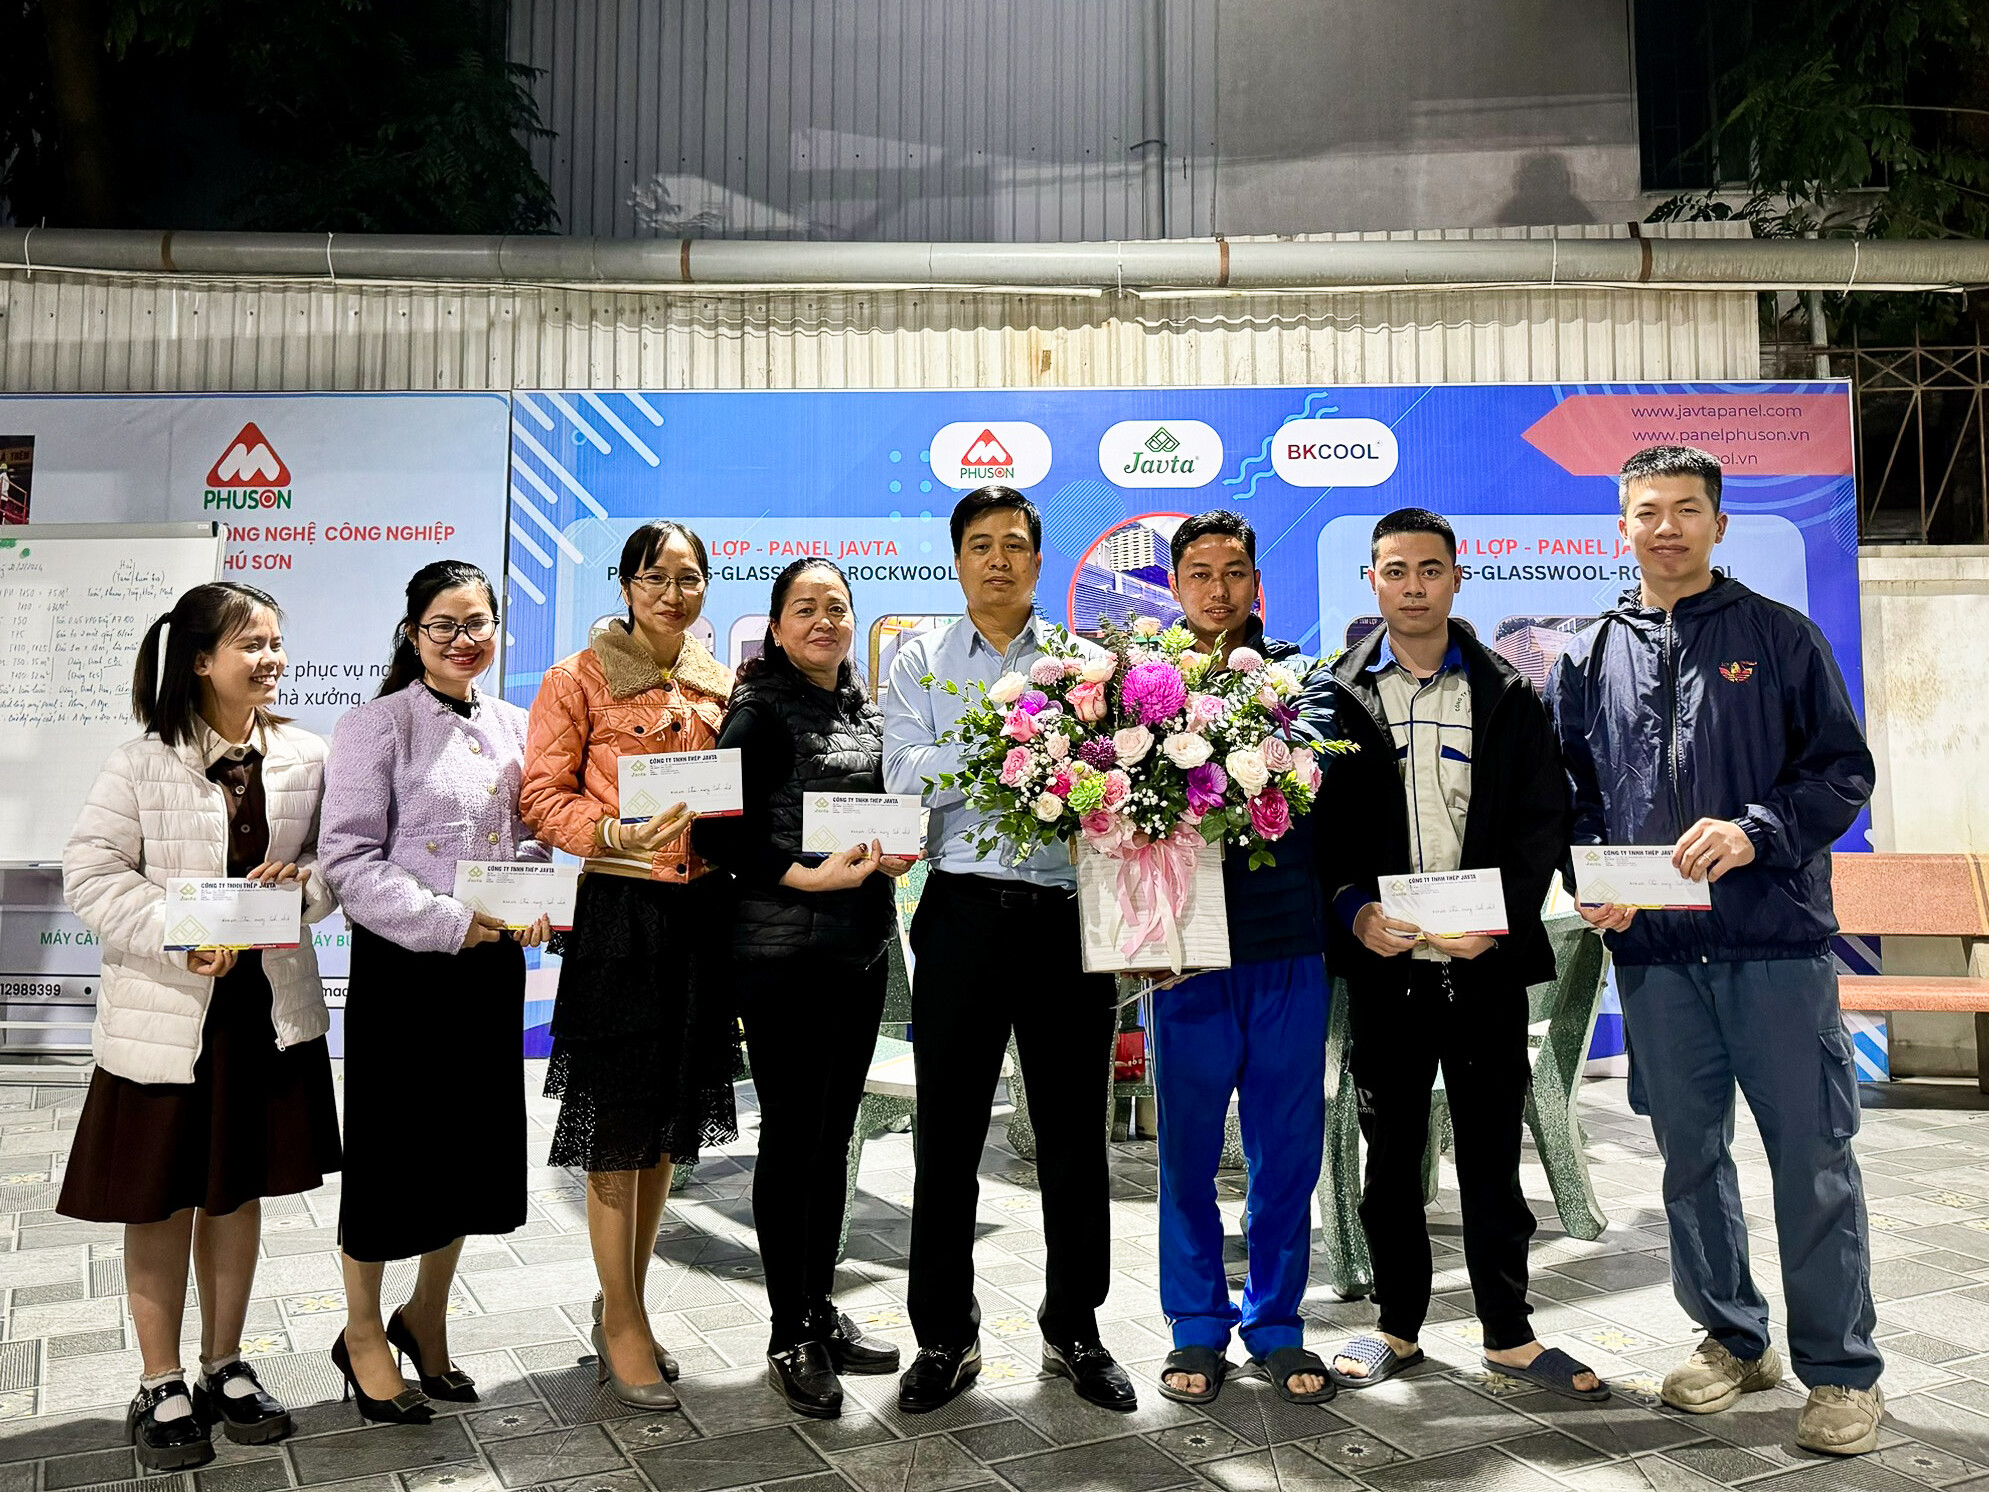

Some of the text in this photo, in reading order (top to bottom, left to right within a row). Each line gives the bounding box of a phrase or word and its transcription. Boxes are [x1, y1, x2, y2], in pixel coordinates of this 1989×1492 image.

[1631, 404, 1802, 420] www.javtapanel.com
[1632, 428, 1810, 443] www.panelphuson.vn
[1287, 443, 1380, 460] BKCOOL
[1124, 451, 1196, 474] Javta
[960, 467, 1015, 479] PHUSON
[203, 489, 292, 510] PHUSON
[265, 522, 316, 545] NGHỆ
[325, 522, 381, 541] CÔNG
[386, 521, 455, 545] NGHIỆP
[711, 540, 751, 560] LỢP
[769, 541, 833, 556] PANEL
[838, 541, 898, 560] JAVTA
[1476, 538, 1518, 559] LỢP
[1538, 539, 1607, 555] PANEL
[224, 550, 292, 570] HÚ SƠN
[295, 661, 338, 682] phục
[343, 664, 364, 681] vụ
[274, 688, 298, 705] hà
[40, 929, 71, 945] MÁY
[314, 931, 332, 946] ÁY
[0, 983, 61, 996] 12989399
